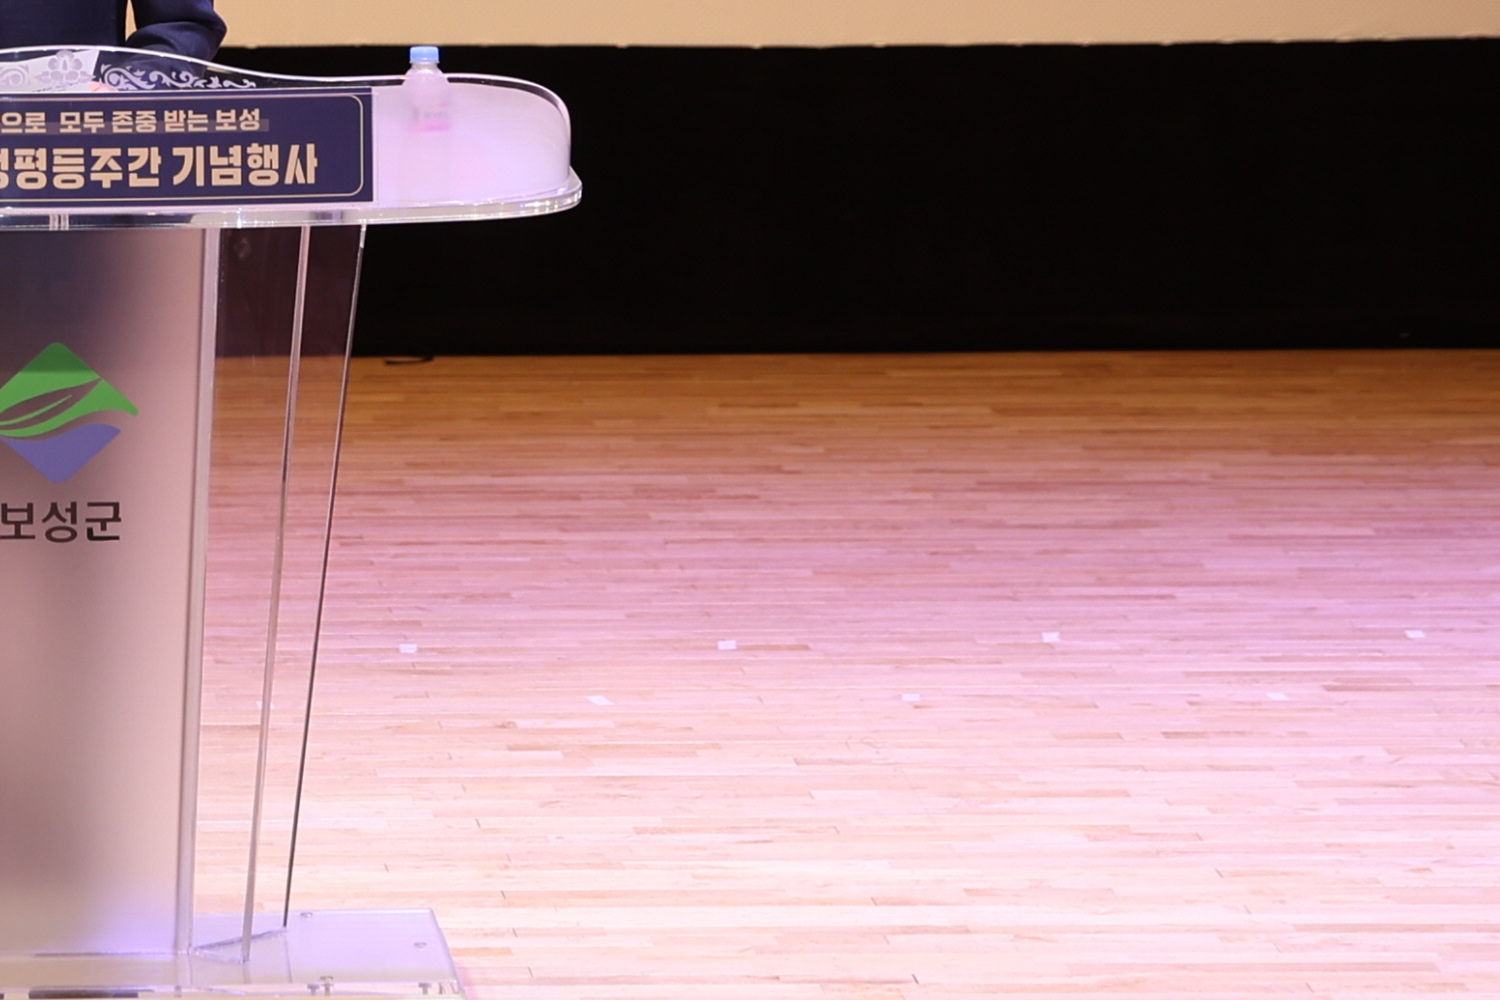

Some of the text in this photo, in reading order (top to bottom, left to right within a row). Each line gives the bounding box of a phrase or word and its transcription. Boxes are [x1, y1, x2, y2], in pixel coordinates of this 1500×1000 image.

[60, 110, 106, 133] 모두
[112, 110, 158, 133] 존중
[164, 109, 209, 132] 받는
[215, 108, 260, 131] 보성
[172, 143, 318, 187] 기념행사
[0, 501, 122, 543] 보성군
